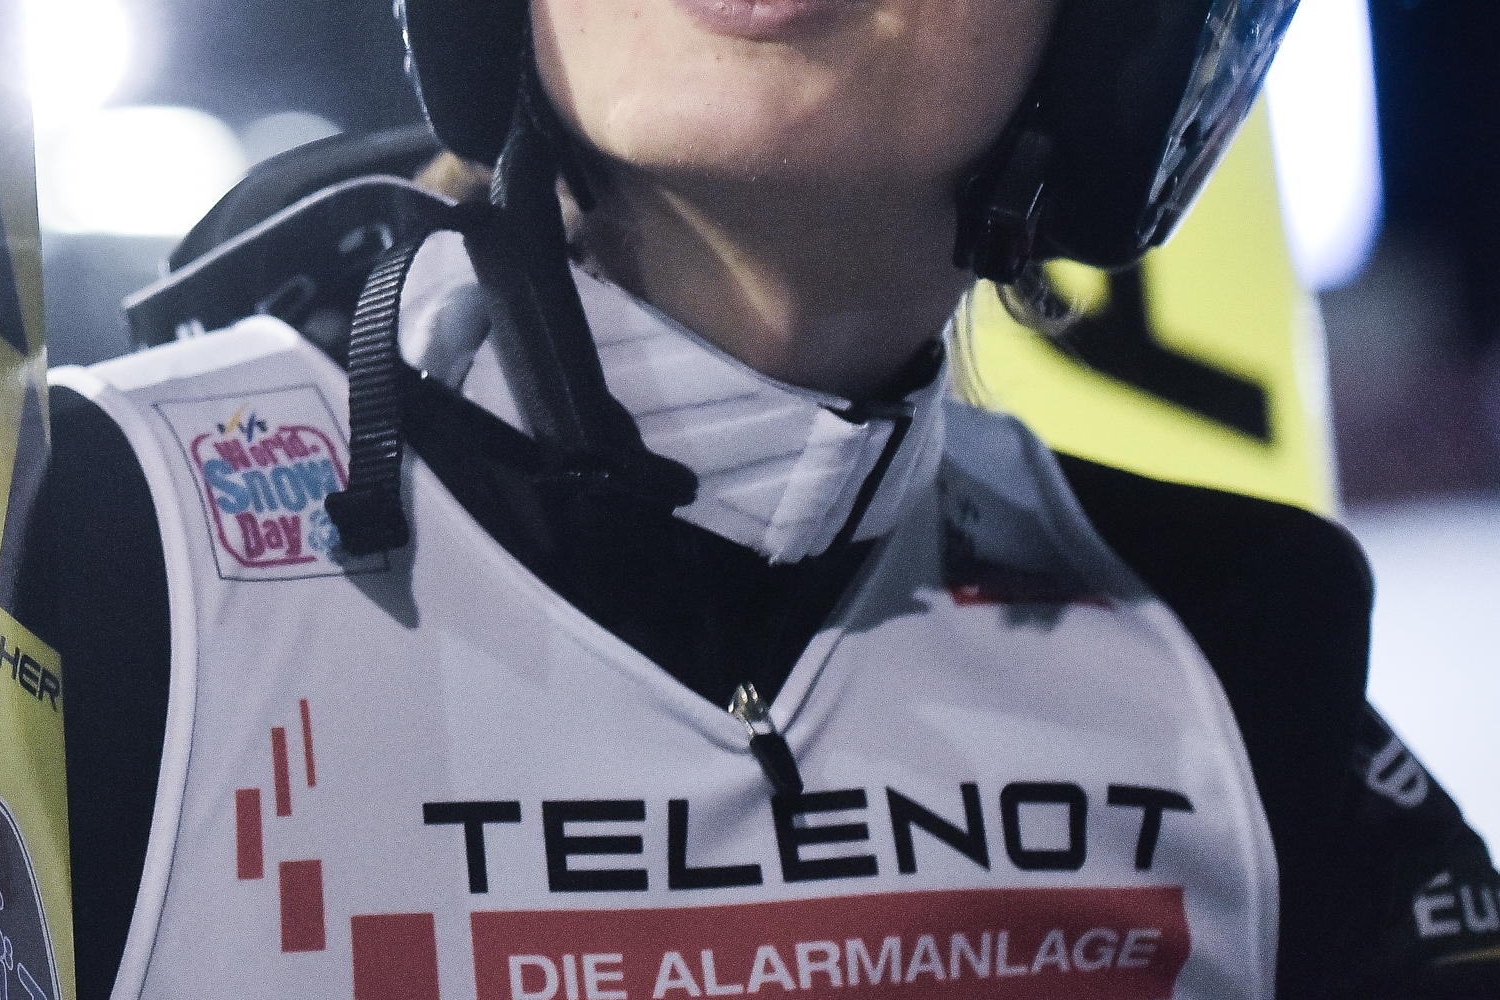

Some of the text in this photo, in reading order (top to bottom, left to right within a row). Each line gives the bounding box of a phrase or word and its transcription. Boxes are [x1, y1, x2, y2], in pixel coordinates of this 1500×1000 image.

[203, 458, 340, 514] Snow
[235, 511, 303, 559] Day
[422, 781, 1195, 894] TELENOT
[508, 928, 1163, 1000] DIE ALARMANLAGE
